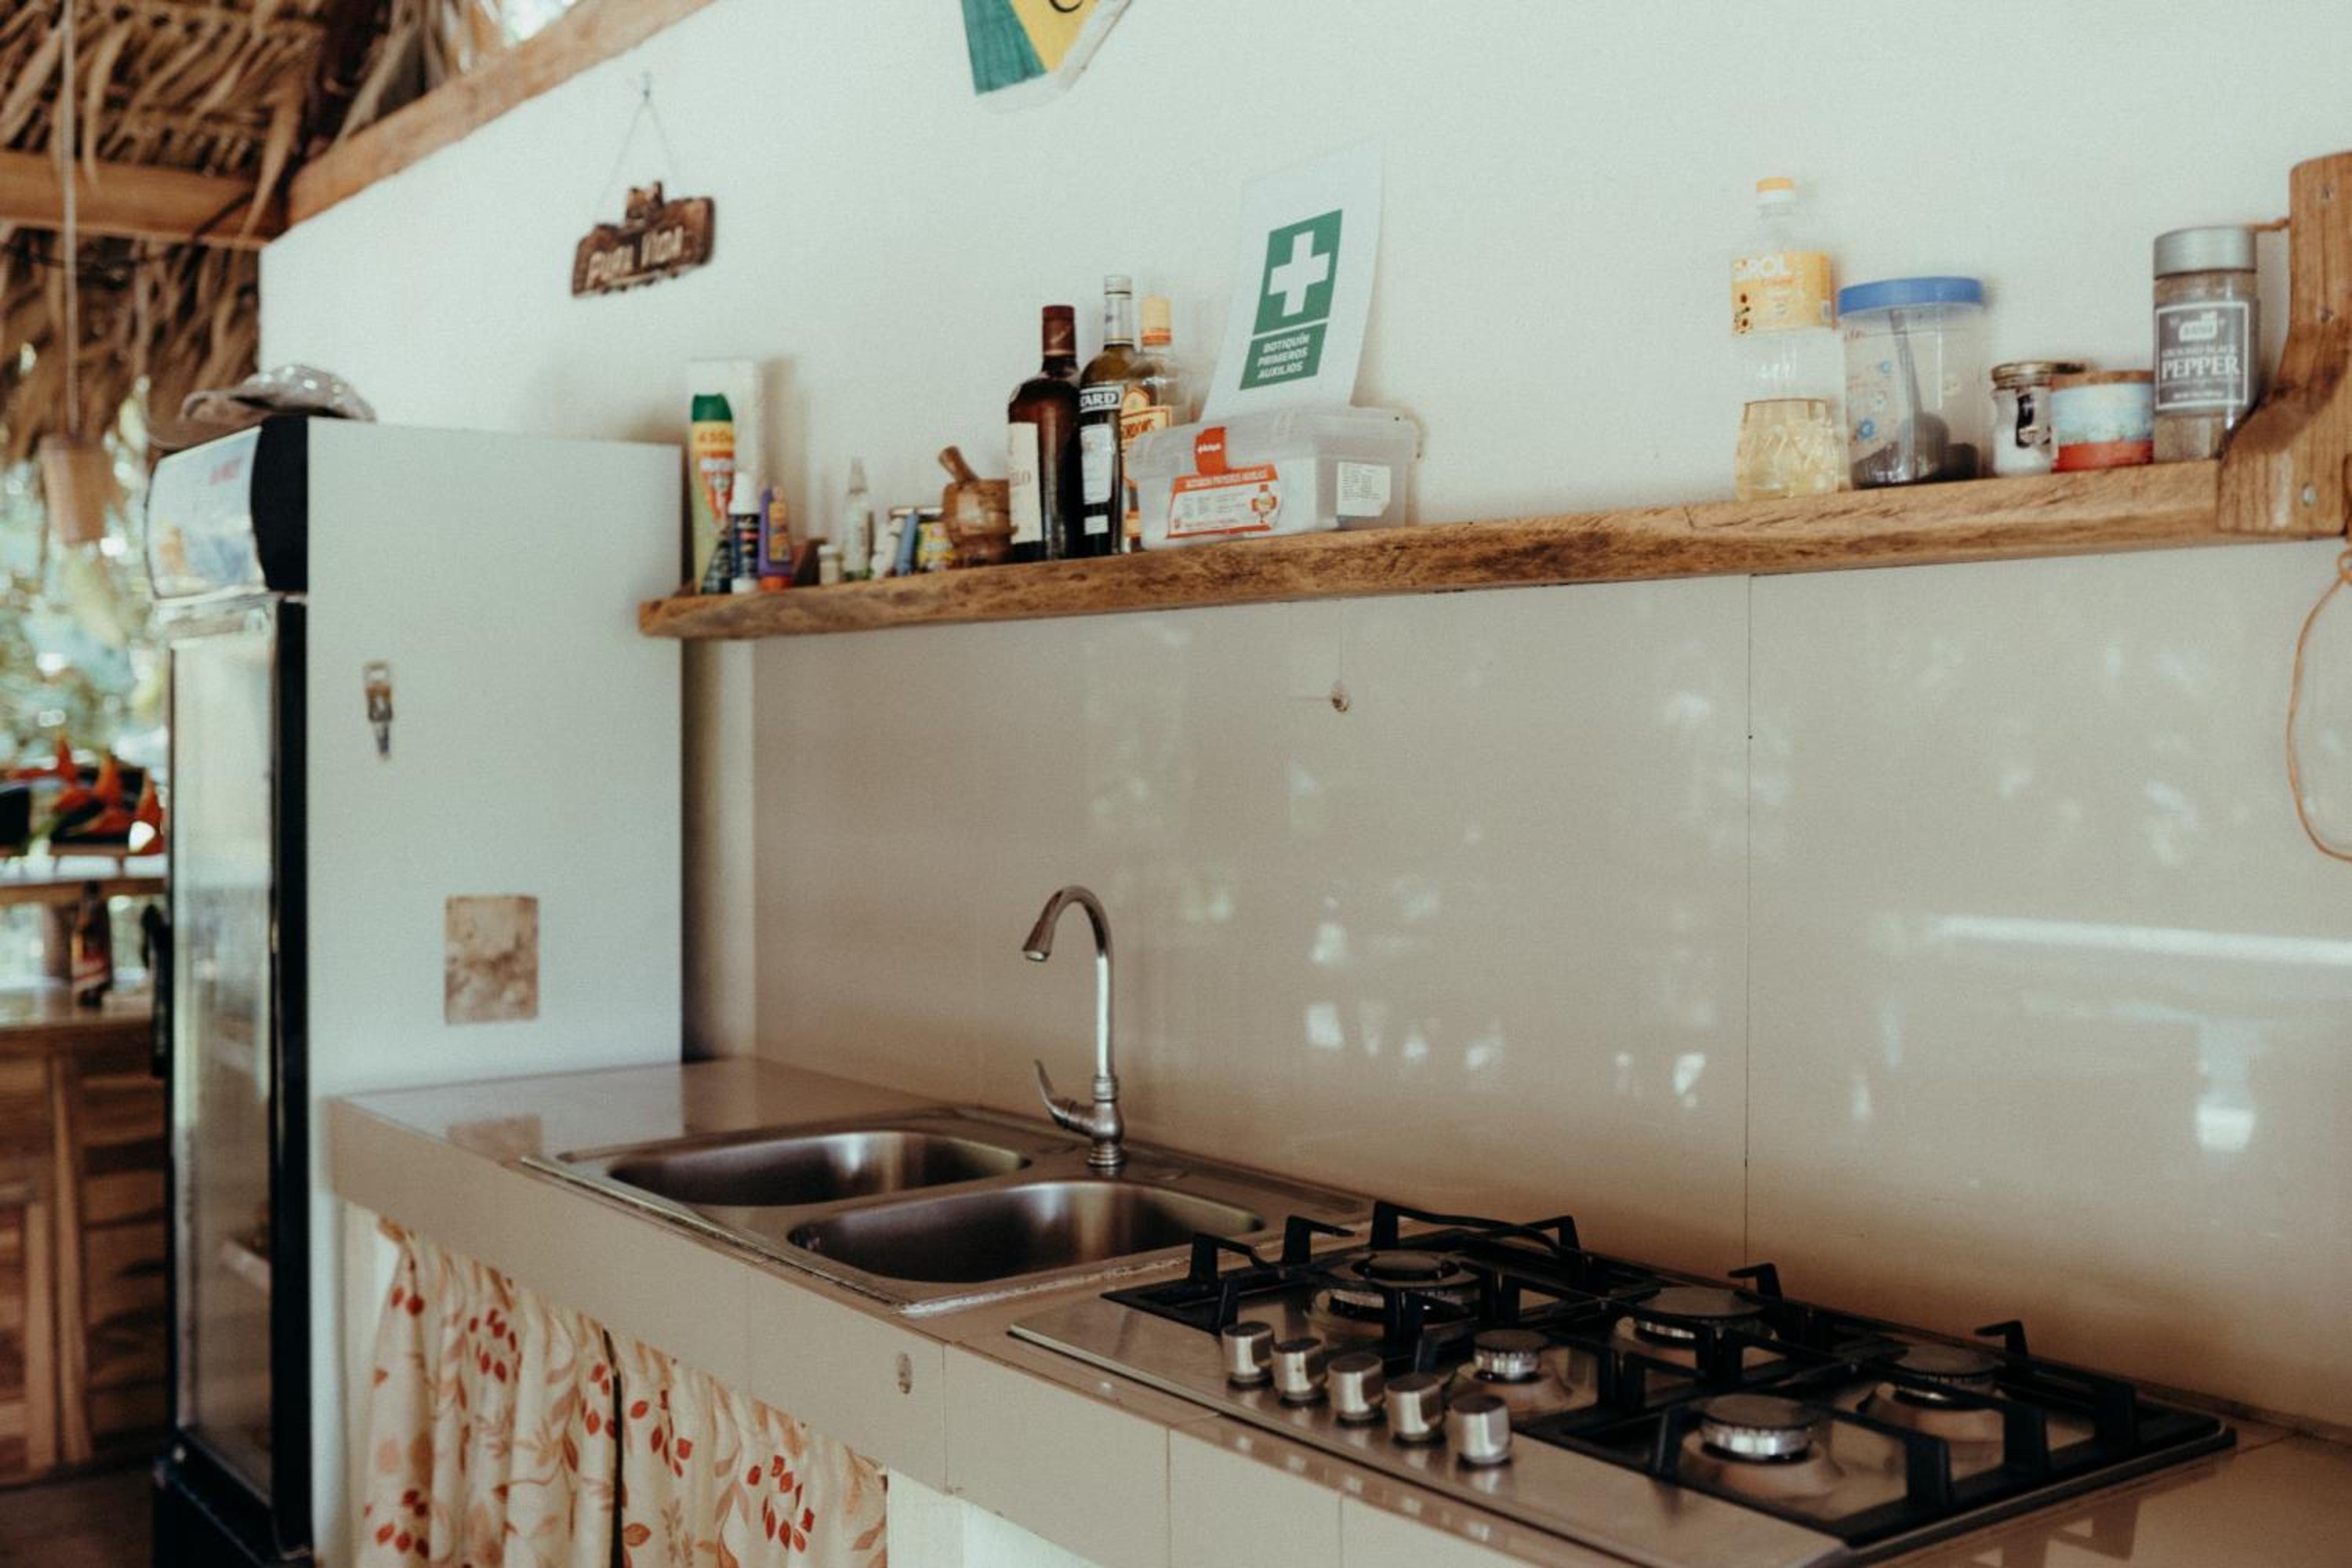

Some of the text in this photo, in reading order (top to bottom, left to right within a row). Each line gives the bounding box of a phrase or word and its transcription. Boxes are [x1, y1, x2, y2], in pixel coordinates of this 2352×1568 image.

[1264, 332, 1310, 353] BOTIQUÍN
[1258, 347, 1308, 367] PRIMEROS
[2161, 354, 2240, 380] PEPPER
[1257, 361, 1303, 379] AUXILIOS
